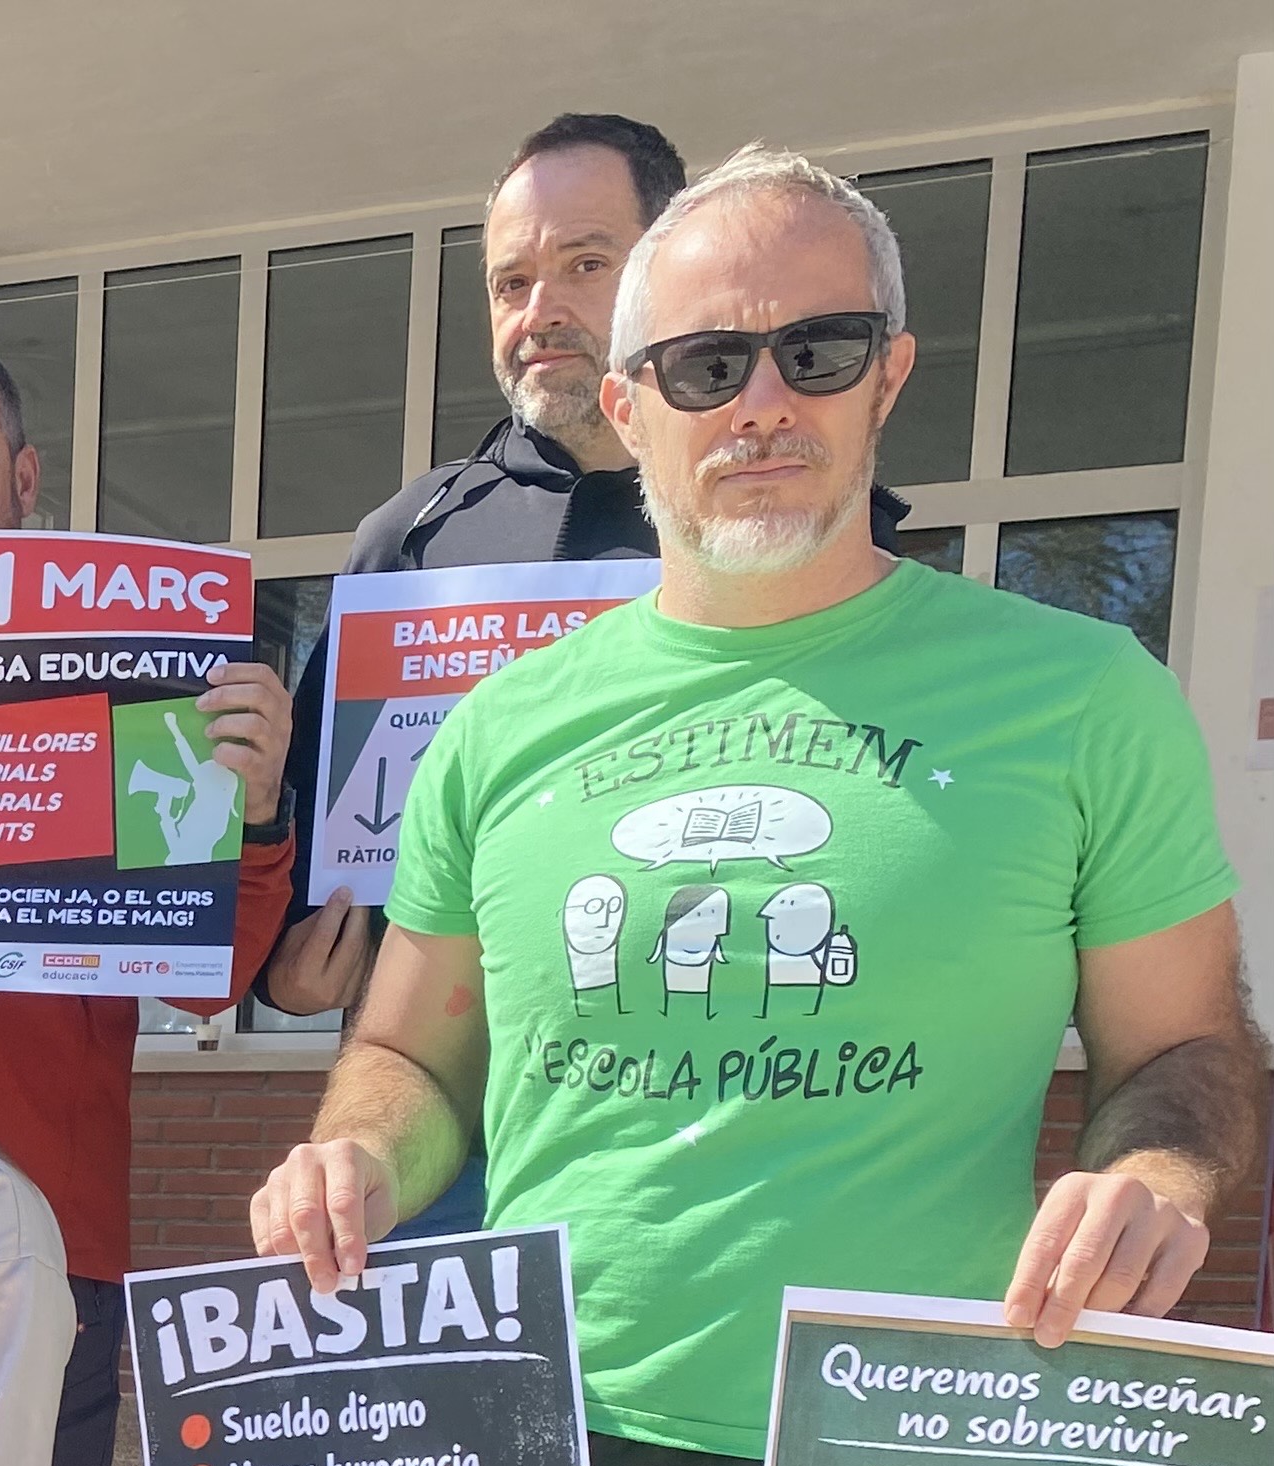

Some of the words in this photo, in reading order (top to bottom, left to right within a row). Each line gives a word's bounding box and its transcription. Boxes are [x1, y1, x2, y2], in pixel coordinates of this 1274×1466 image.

[42, 561, 230, 624] MARÇ
[393, 613, 505, 647] BAJAR
[516, 611, 587, 639] LAS
[575, 711, 924, 802] ESTIMEM
[337, 845, 397, 864] RÀTIO
[16, 908, 43, 924] EL
[47, 908, 93, 925] MES
[97, 909, 127, 925] DE
[131, 909, 195, 926] MAIG!
[64, 889, 98, 907] JA,
[103, 890, 121, 904] O
[125, 890, 151, 905] EL
[156, 890, 214, 907] CURS
[0, 959, 28, 970] CSIF
[118, 961, 153, 974] UGT
[718, 1034, 924, 1102] PÚBLICA
[152, 1245, 523, 1386] ¡BASTA!
[820, 1341, 1041, 1401] Queremos
[1067, 1376, 1267, 1434] enseñar,
[222, 1392, 330, 1444] Sueldo
[338, 1391, 427, 1443] digno
[898, 1412, 949, 1440] no
[965, 1404, 1189, 1459] sobrevivir
